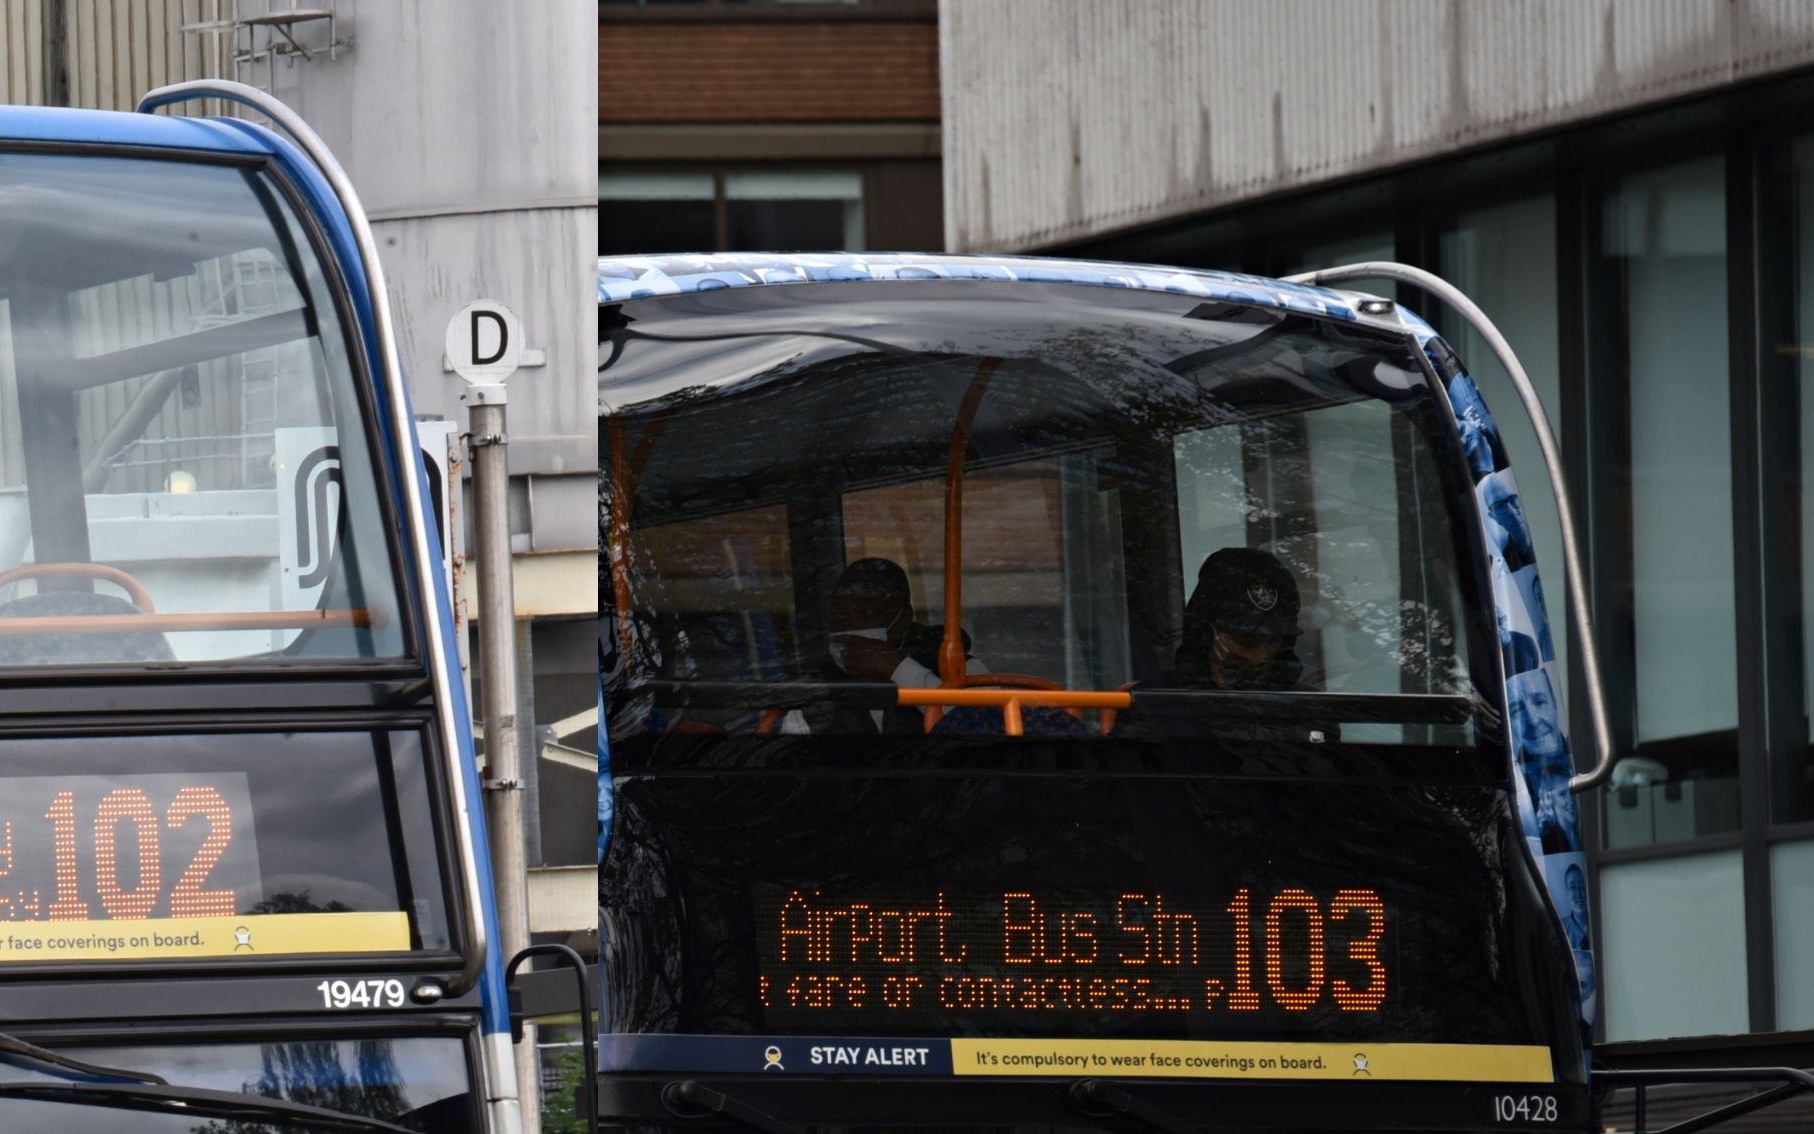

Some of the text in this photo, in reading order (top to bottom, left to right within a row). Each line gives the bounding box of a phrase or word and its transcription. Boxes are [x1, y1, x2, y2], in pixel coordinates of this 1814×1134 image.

[471, 310, 508, 365] D
[44, 785, 235, 922] 102
[7, 934, 43, 950] face
[47, 933, 126, 952] coverings
[130, 936, 149, 947] on
[153, 931, 205, 947] board.
[781, 890, 1198, 965] Airport Bus Stn
[1226, 888, 1386, 1011] 103
[317, 979, 405, 1008] 19479
[883, 976, 923, 1008] or
[810, 1046, 929, 1066] STAY ALERT
[976, 1051, 1327, 1072] It's compulsory to wear face coverings on board.
[1495, 1095, 1558, 1122] 10428
